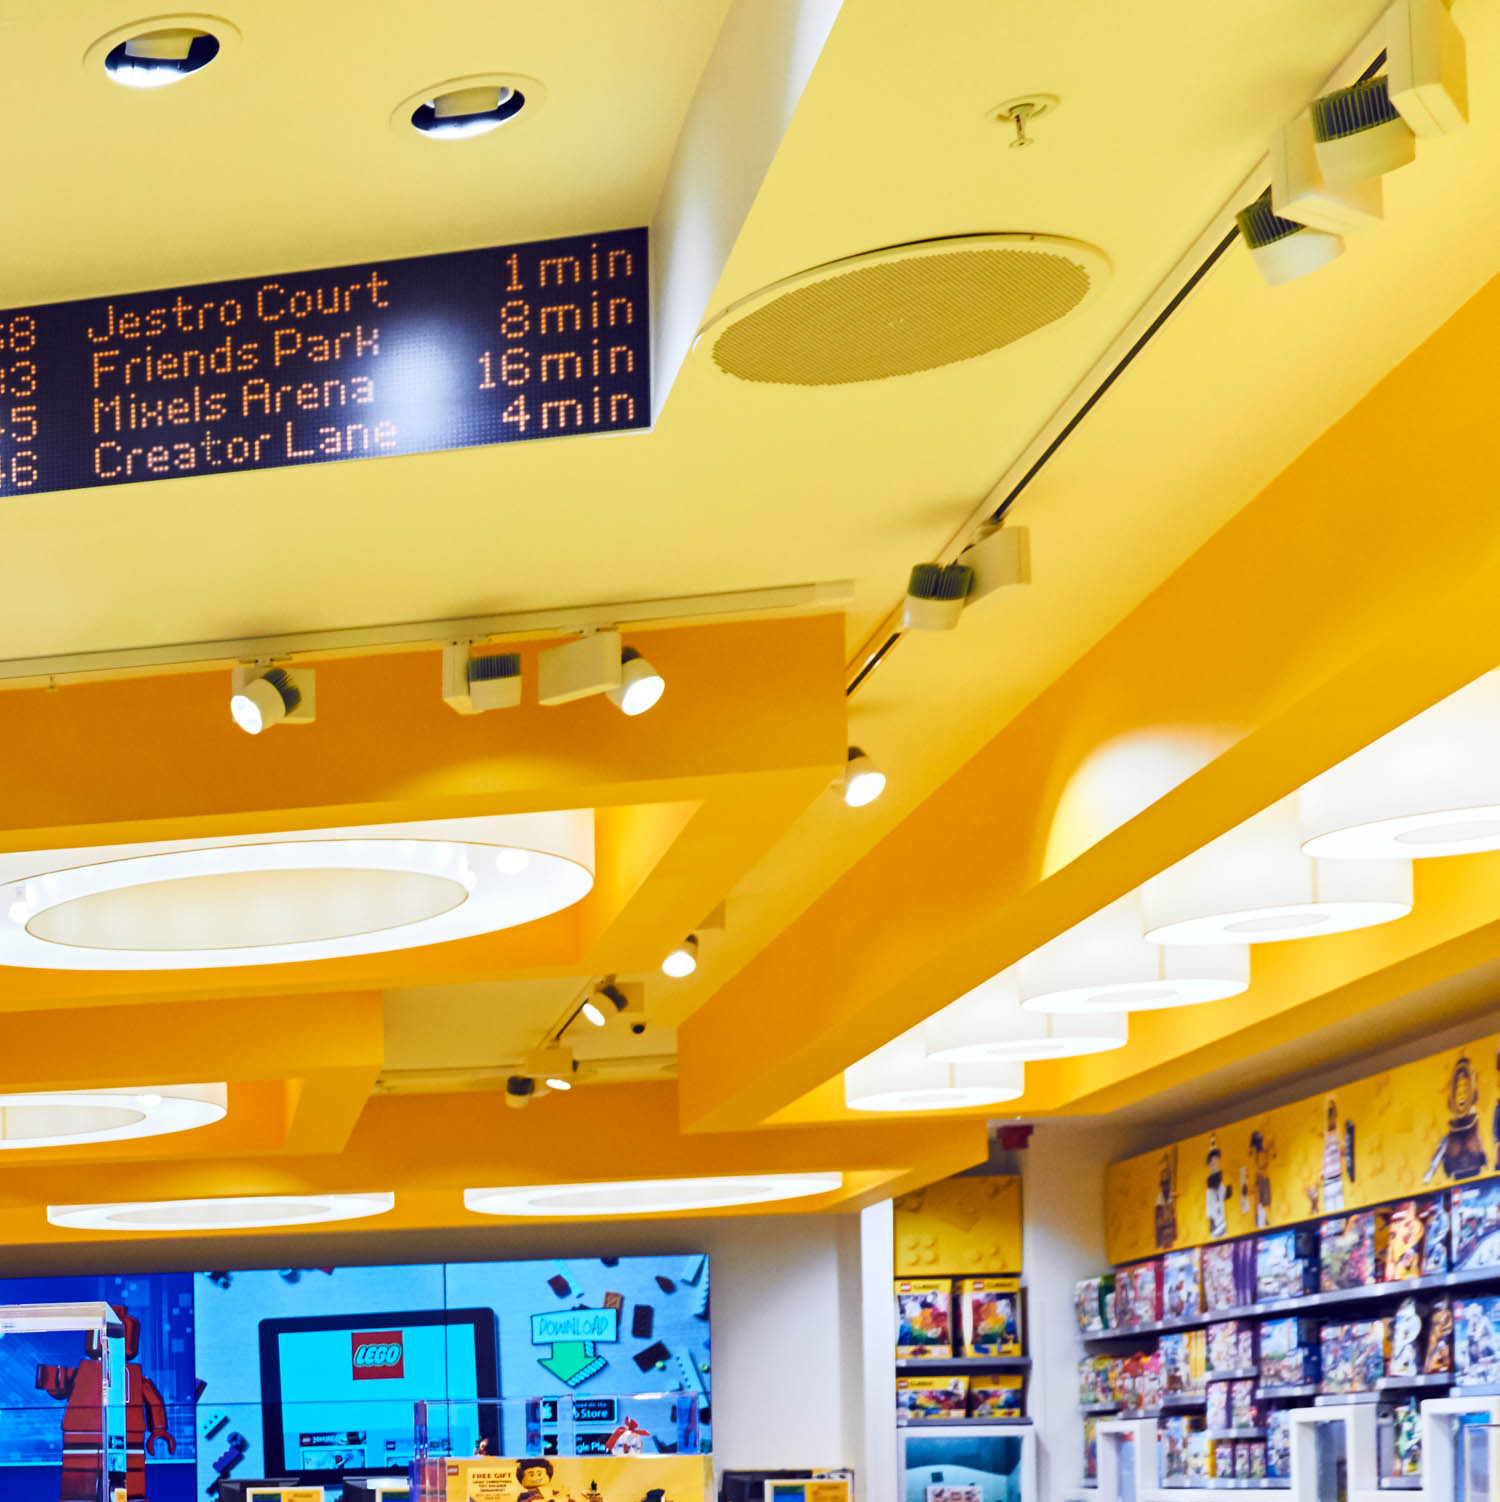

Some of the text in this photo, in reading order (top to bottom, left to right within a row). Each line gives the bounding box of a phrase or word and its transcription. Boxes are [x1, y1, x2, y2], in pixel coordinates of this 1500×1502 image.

[87, 293, 243, 345] Jestro
[255, 271, 391, 322] Court
[92, 335, 260, 390] Friends
[273, 324, 382, 367] Park
[93, 384, 229, 435] Mixels
[240, 373, 375, 417] Arena
[93, 429, 272, 480] Creator
[285, 418, 399, 461] Lane
[354, 1343, 401, 1367] LEGO
[538, 1315, 608, 1337] DOWNLOAD
[580, 1408, 608, 1418] Store
